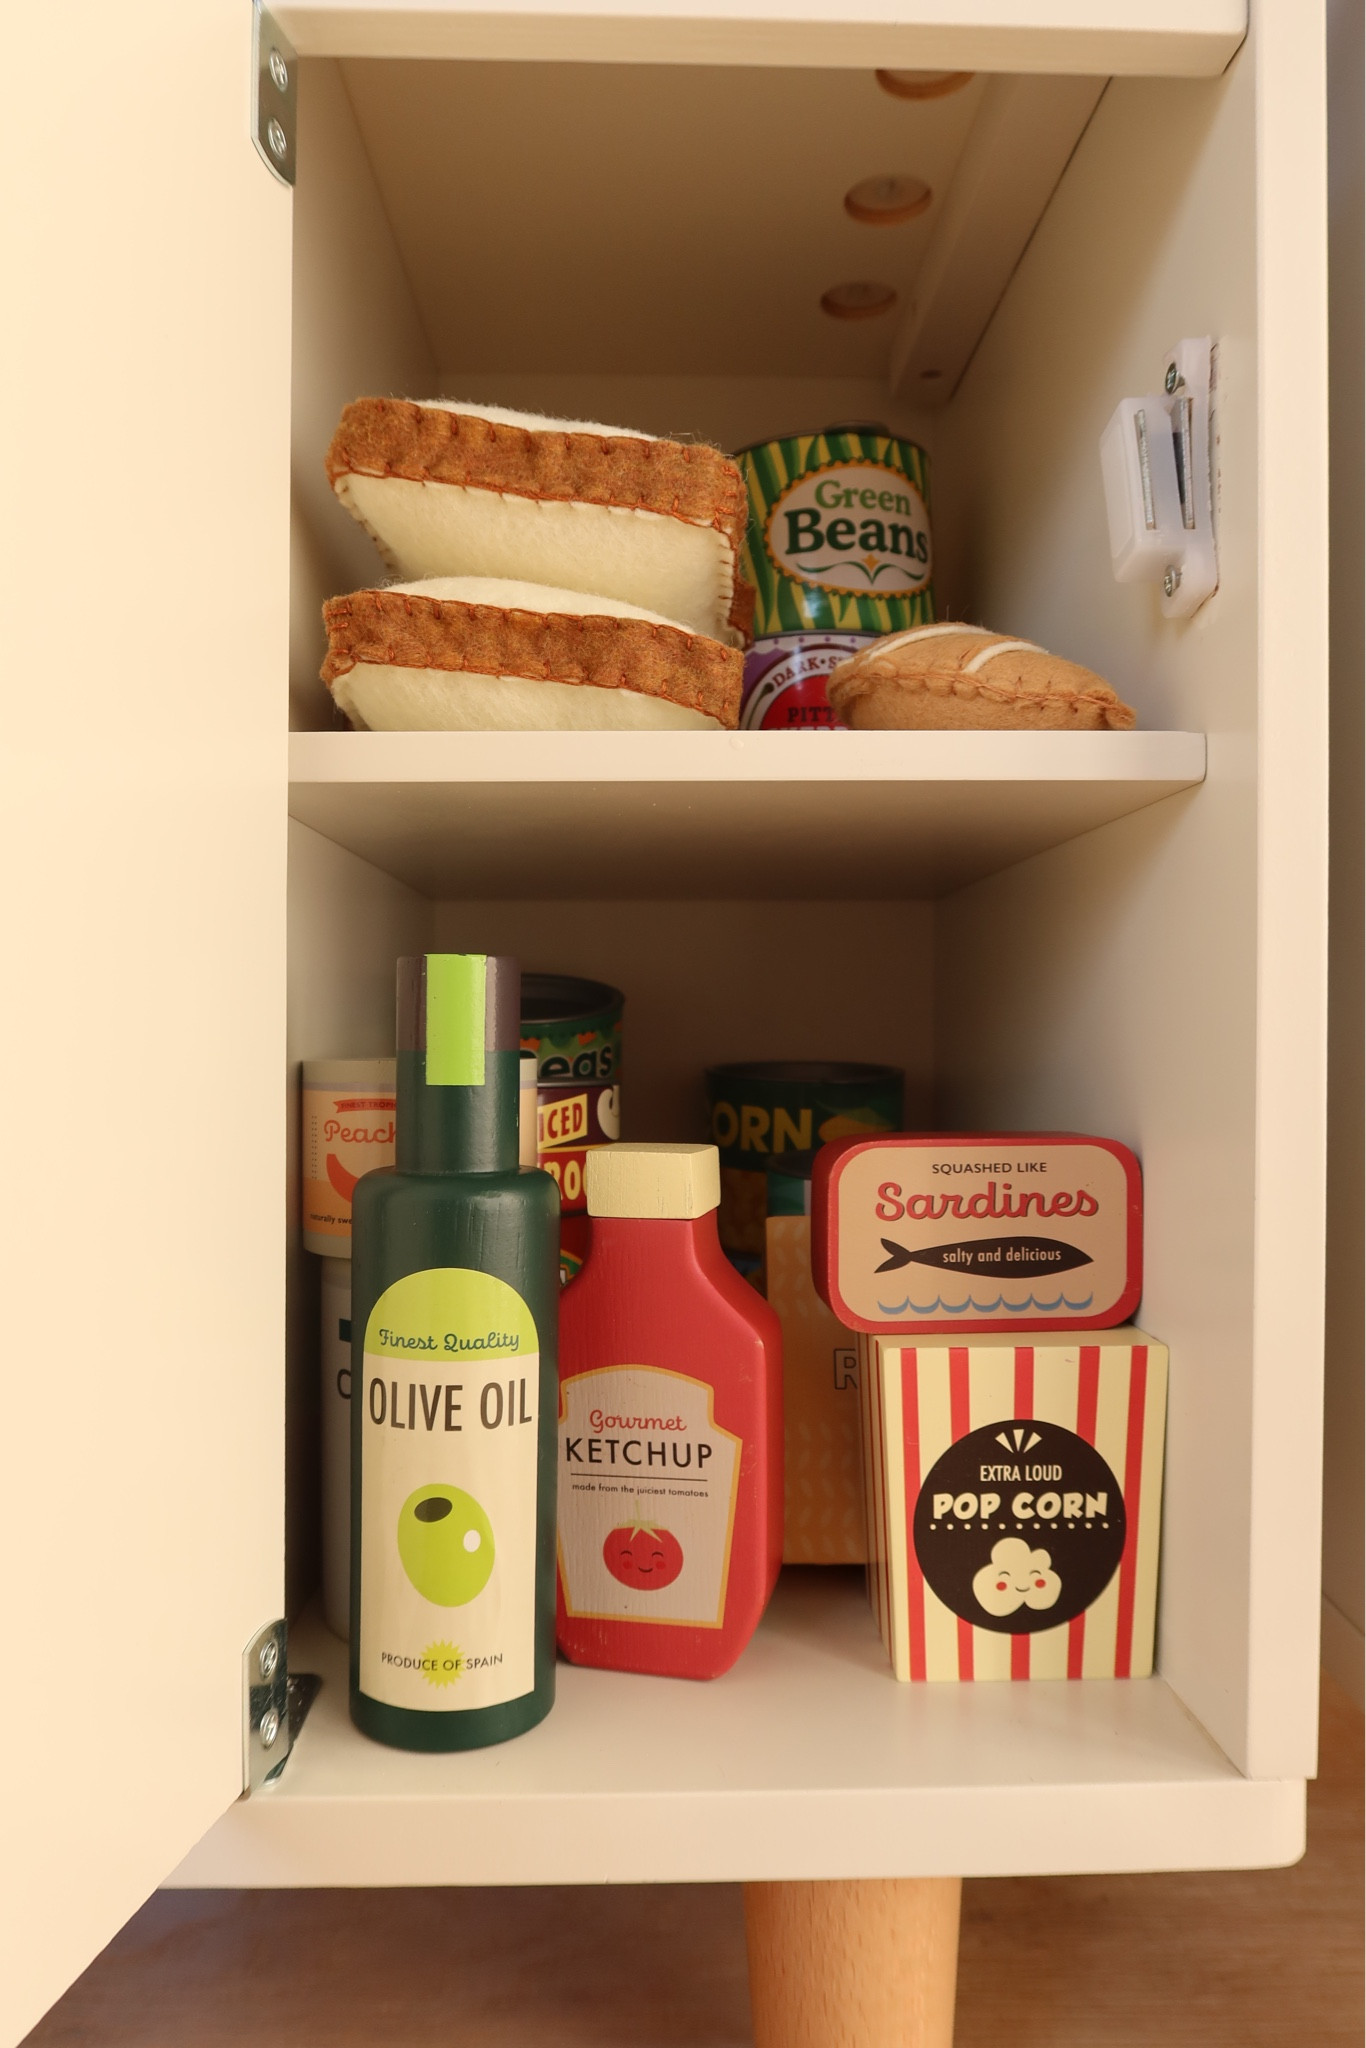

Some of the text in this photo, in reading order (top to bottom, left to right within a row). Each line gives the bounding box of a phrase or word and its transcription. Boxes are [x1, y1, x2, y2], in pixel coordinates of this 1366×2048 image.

[815, 479, 912, 516] Green
[784, 507, 928, 564] Beans
[521, 1044, 614, 1078] eas
[932, 1162, 1047, 1175] SQUASHED LIKE
[875, 1181, 1099, 1221] Sardines
[943, 1247, 1061, 1266] salty and delicious
[379, 1328, 519, 1352] Finest Quality
[369, 1377, 463, 1431] OLIVE
[480, 1378, 532, 1429] OIL
[589, 1409, 687, 1433] Gourmet
[566, 1437, 712, 1468] KETCHUP
[980, 1465, 1062, 1482] EXTRA LOUD
[572, 1483, 709, 1498] made from the juiciest tomatoes
[933, 1492, 1108, 1520] POP CORN
[381, 1651, 503, 1671] PRODUCE OF SPAIN
